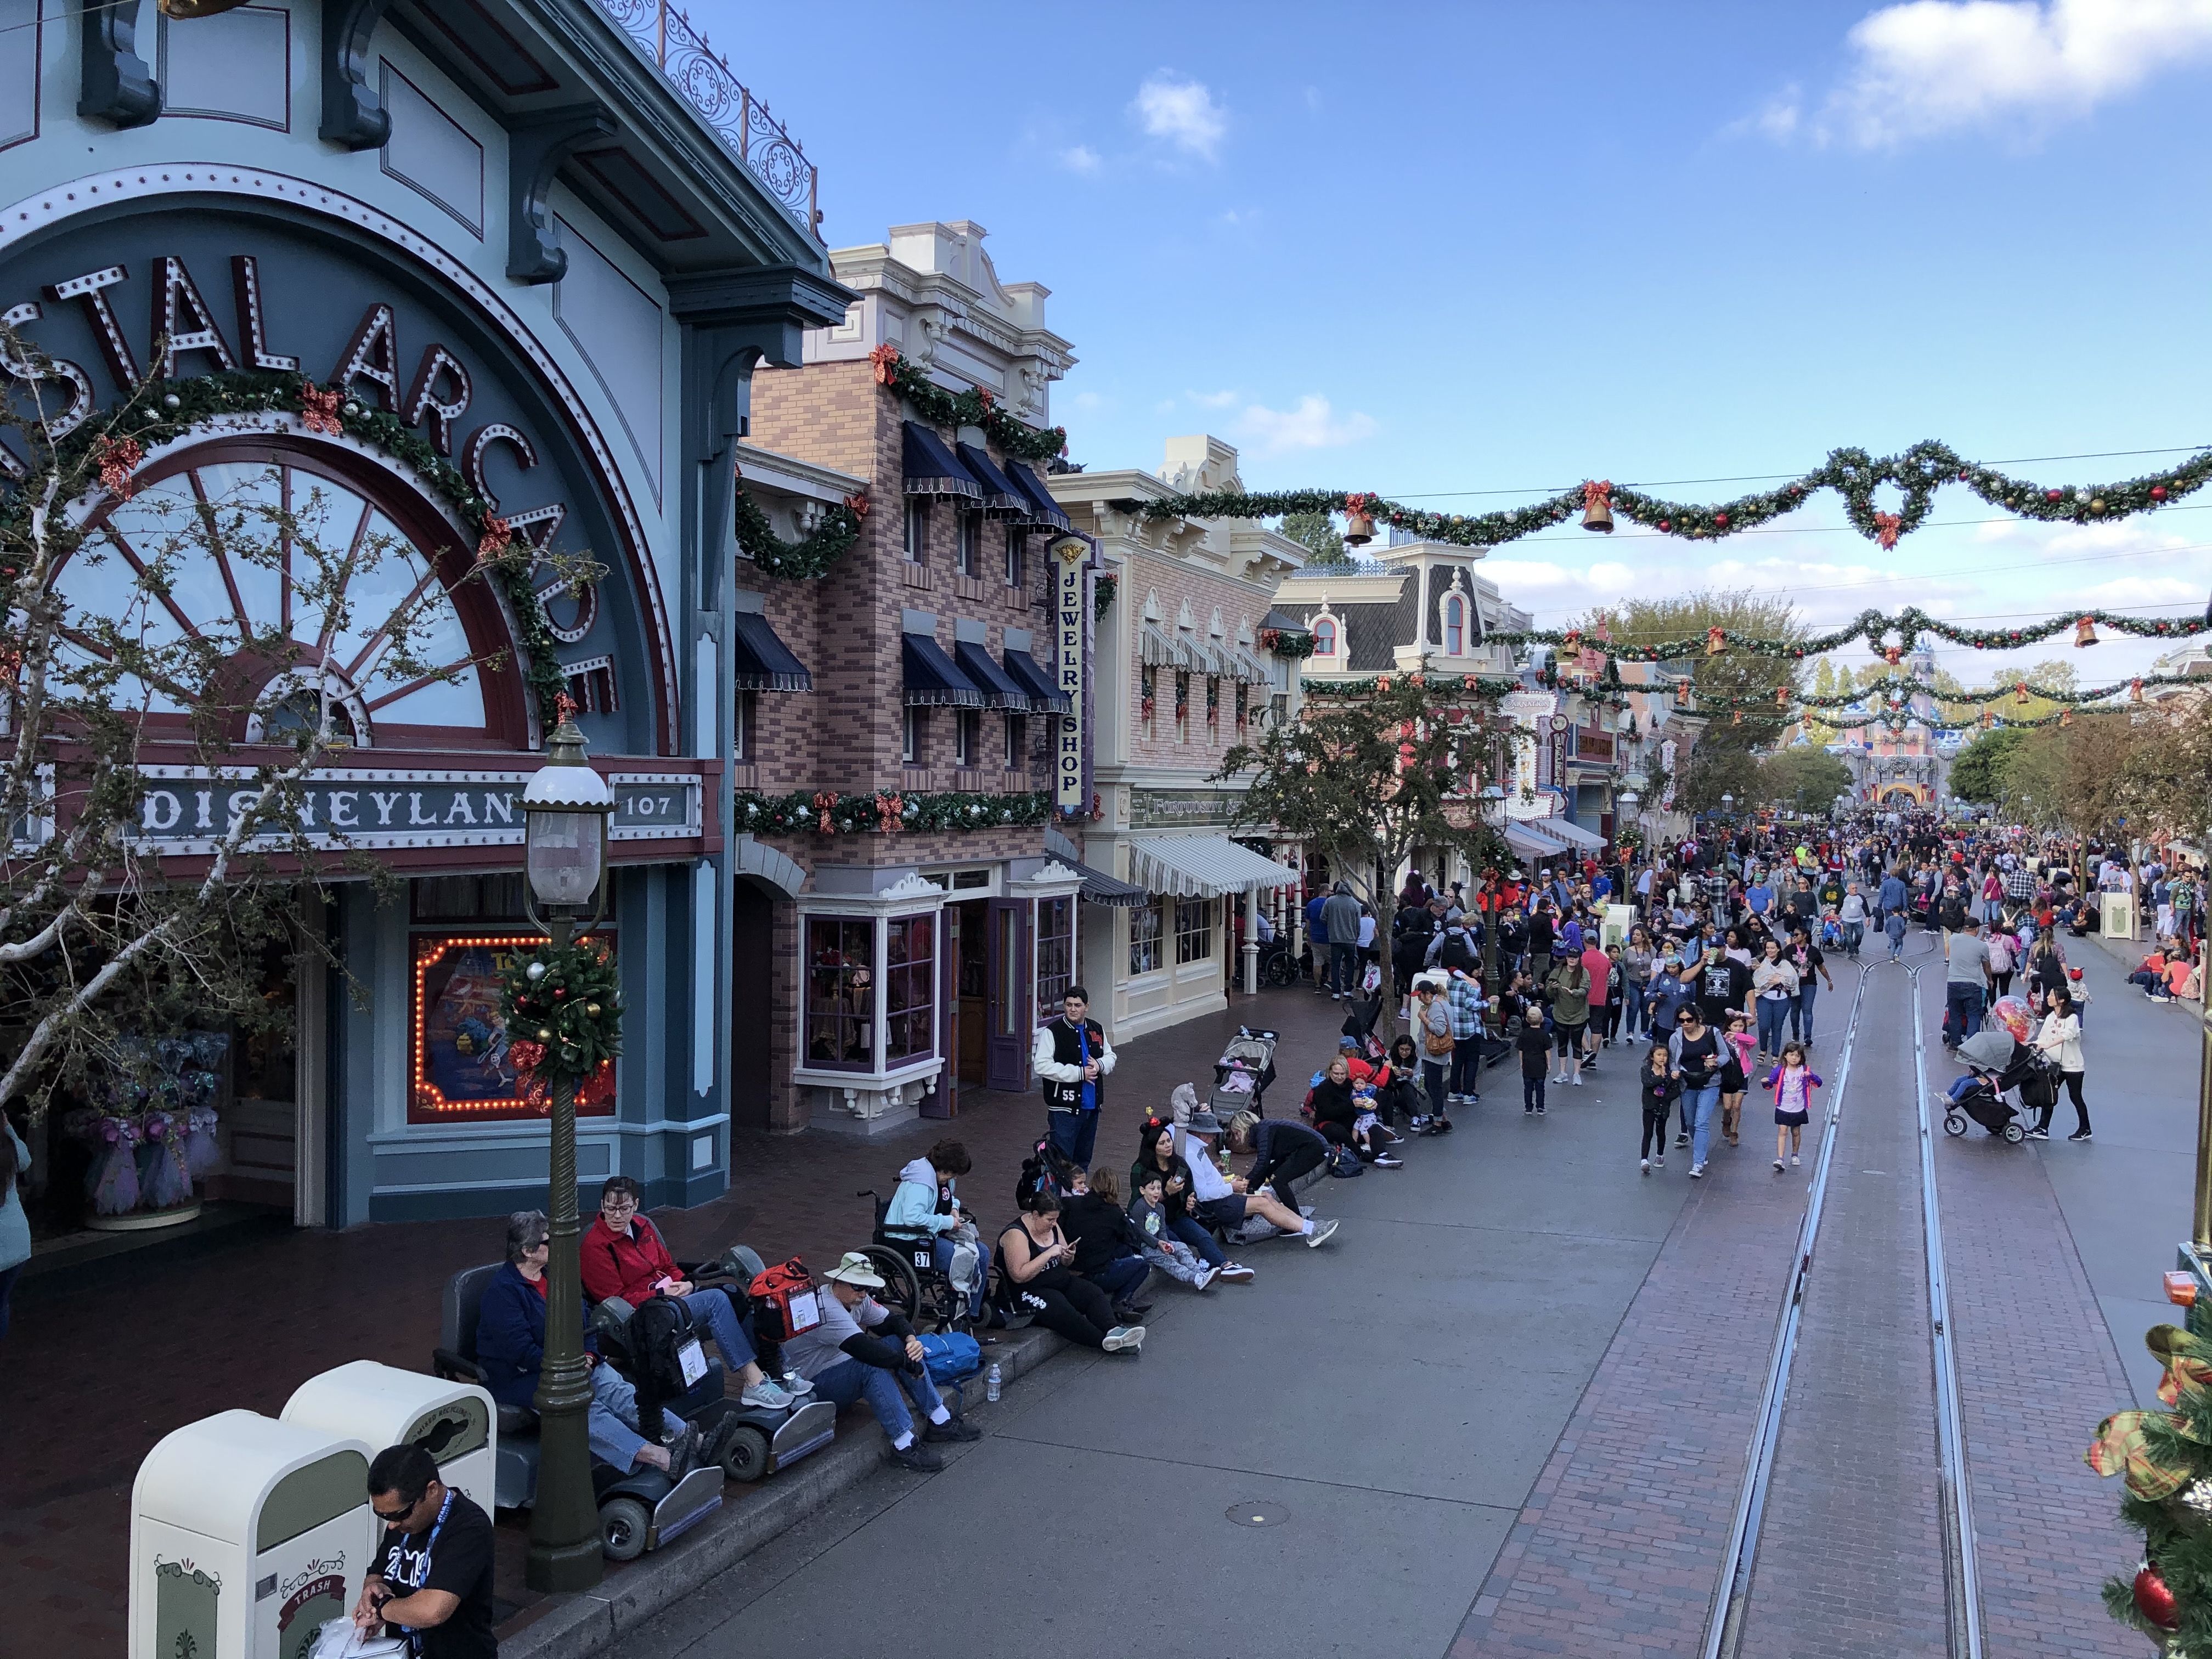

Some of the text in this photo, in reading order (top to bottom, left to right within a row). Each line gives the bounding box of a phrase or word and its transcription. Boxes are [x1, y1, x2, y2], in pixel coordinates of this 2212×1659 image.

[0, 255, 619, 714] STAL ARCADE
[1060, 572, 1080, 792] JEWELRY SHOP
[1503, 698, 1550, 710] CARNATION
[142, 791, 527, 829] DISNEYLAN
[627, 796, 671, 816] 107
[1152, 798, 1224, 817] FORTUOSITY
[1062, 1090, 1075, 1101] 55
[916, 1252, 928, 1267] 37
[417, 1414, 437, 1436] MIXED
[437, 1505, 447, 1523] STAR
[294, 1579, 331, 1605] TRASH
